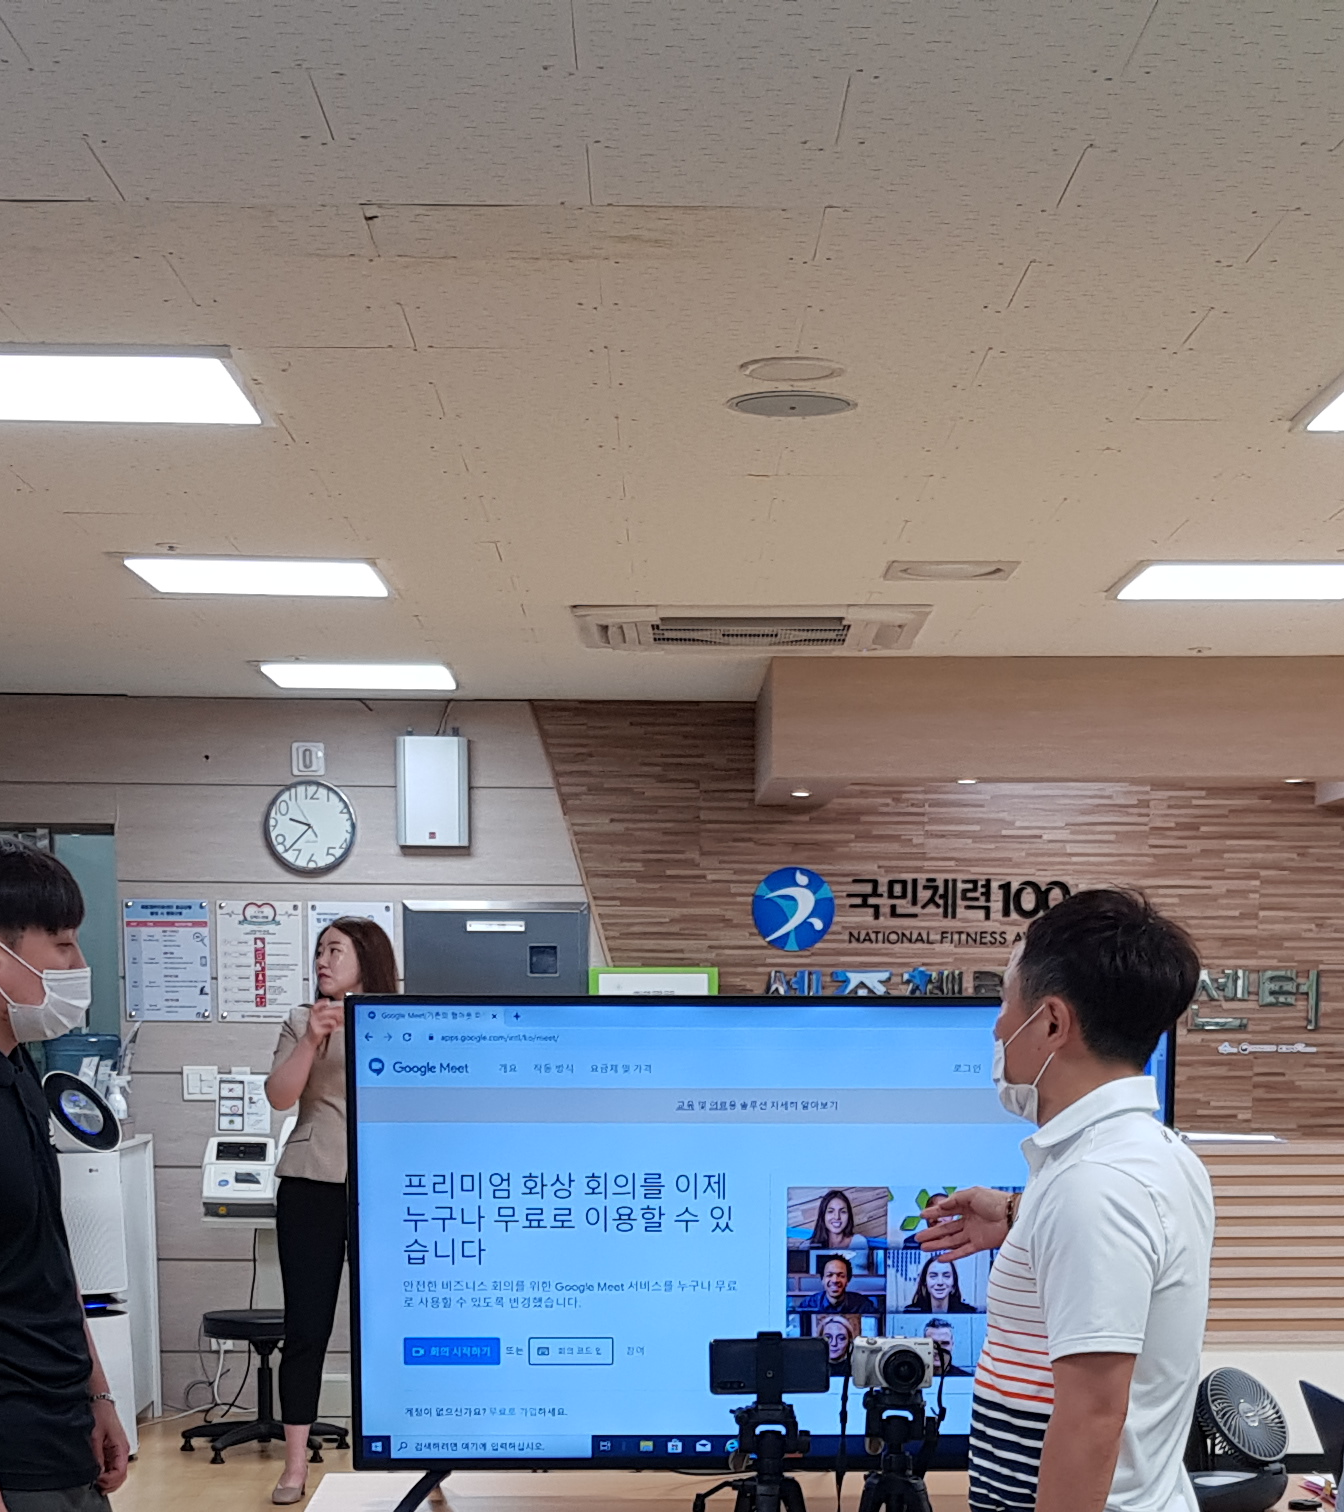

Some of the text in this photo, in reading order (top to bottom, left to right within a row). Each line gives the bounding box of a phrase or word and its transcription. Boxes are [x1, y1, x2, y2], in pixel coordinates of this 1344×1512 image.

[847, 930, 939, 946] NATIONAL
[940, 929, 1008, 946] FITNESS
[392, 1061, 470, 1077] Google Meet
[403, 1171, 727, 1200] 프리미엄 화상 회의를 이제
[403, 1204, 734, 1233] 누구나 무료로 이용할 수 있
[403, 1237, 487, 1266] 습니다
[403, 1280, 438, 1293] 안전한
[441, 1280, 488, 1293] 비즈니스
[490, 1280, 526, 1293] 회의를
[554, 1281, 595, 1294] Google
[597, 1281, 625, 1292] Meet
[627, 1280, 674, 1293] 서비스를
[676, 1279, 711, 1292] 누구나
[714, 1279, 738, 1292] 무료
[403, 1296, 416, 1309] 로
[418, 1296, 453, 1309] 사용할
[455, 1296, 468, 1309] 수
[470, 1296, 505, 1309] 있도록
[505, 1346, 525, 1356] 또는
